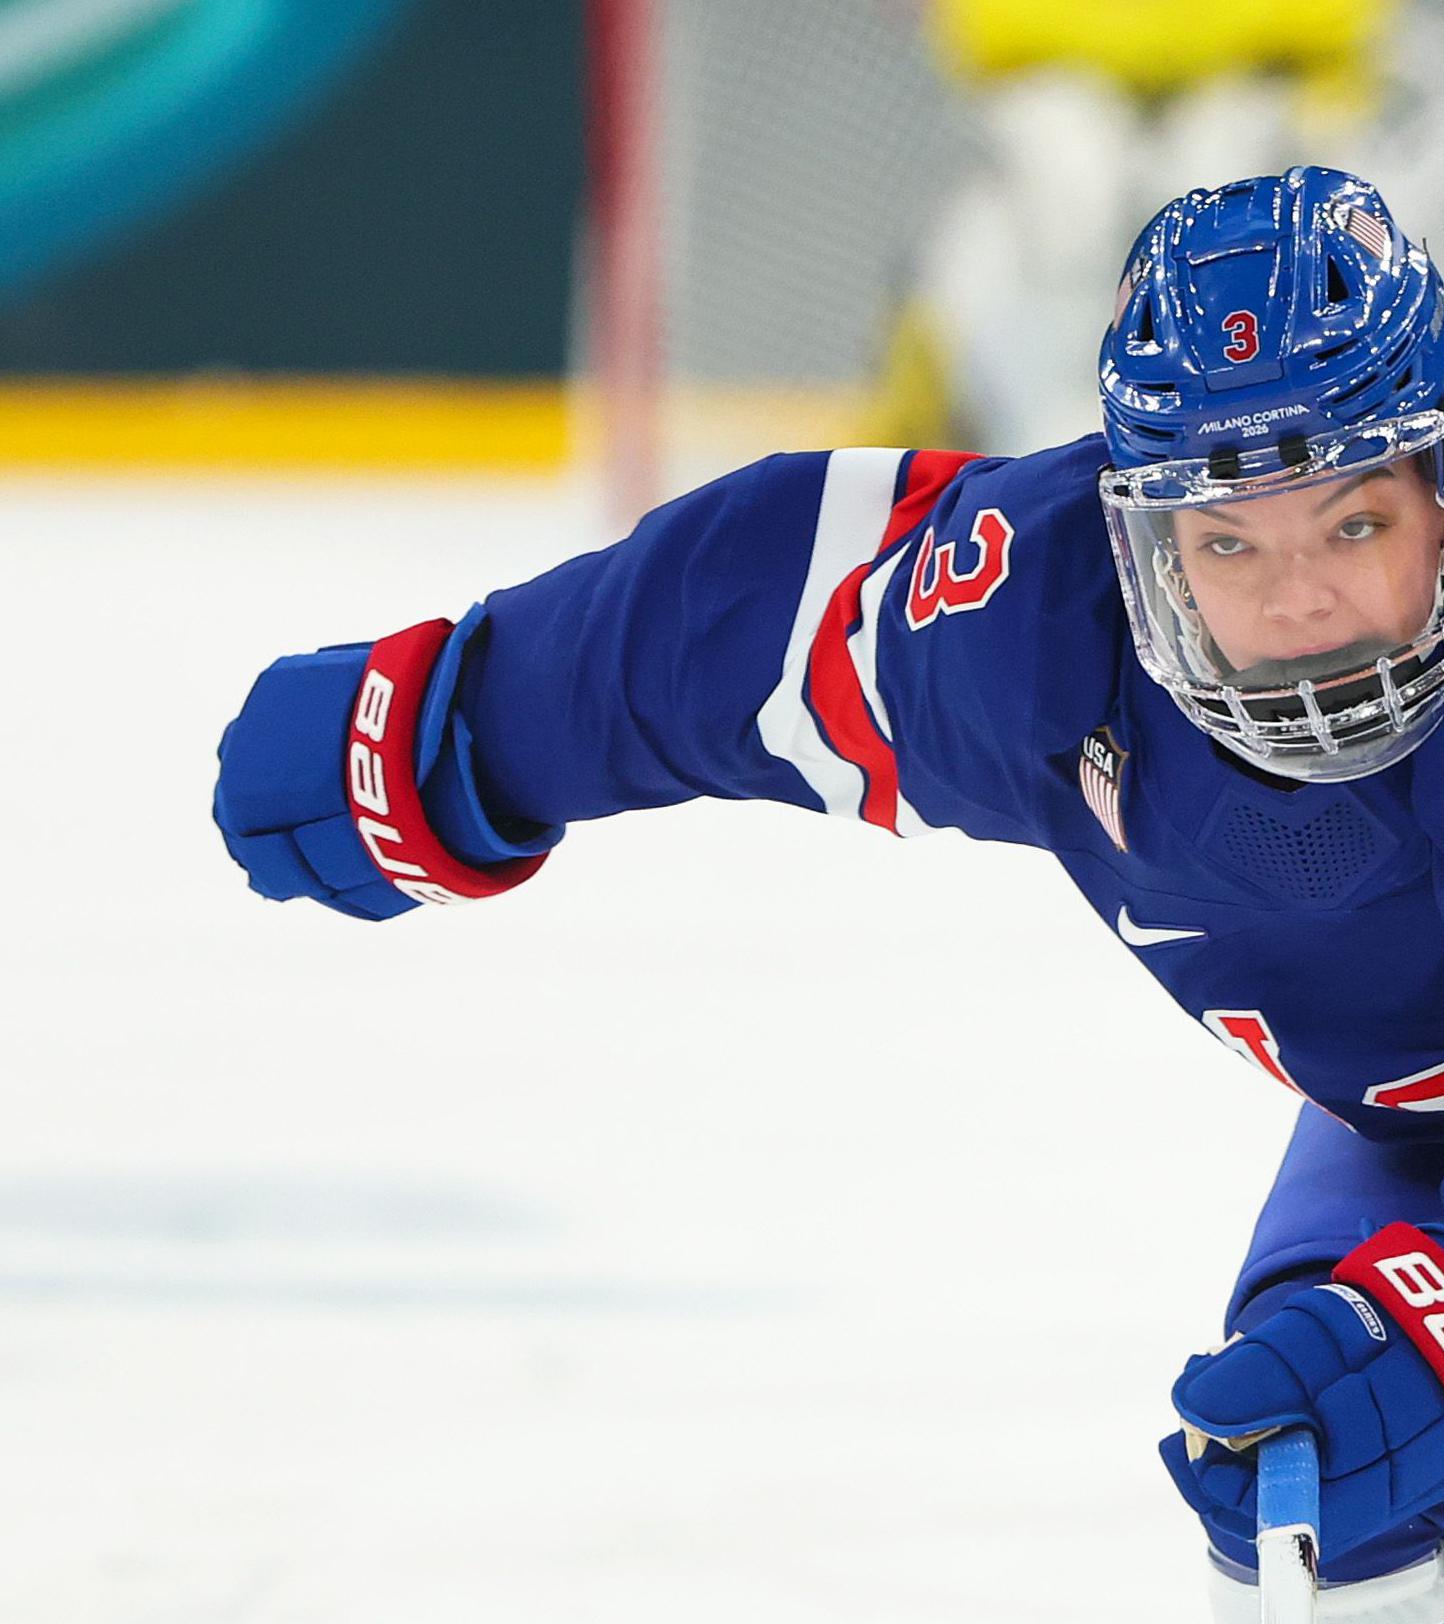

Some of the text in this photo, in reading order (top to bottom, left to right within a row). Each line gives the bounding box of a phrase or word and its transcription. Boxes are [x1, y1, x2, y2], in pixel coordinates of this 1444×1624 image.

[1221, 309, 1261, 364] 3
[1197, 404, 1310, 435] MILANO CORTINA
[1242, 424, 1270, 437] 2026
[904, 508, 1015, 632] 3
[1083, 736, 1114, 778] USA
